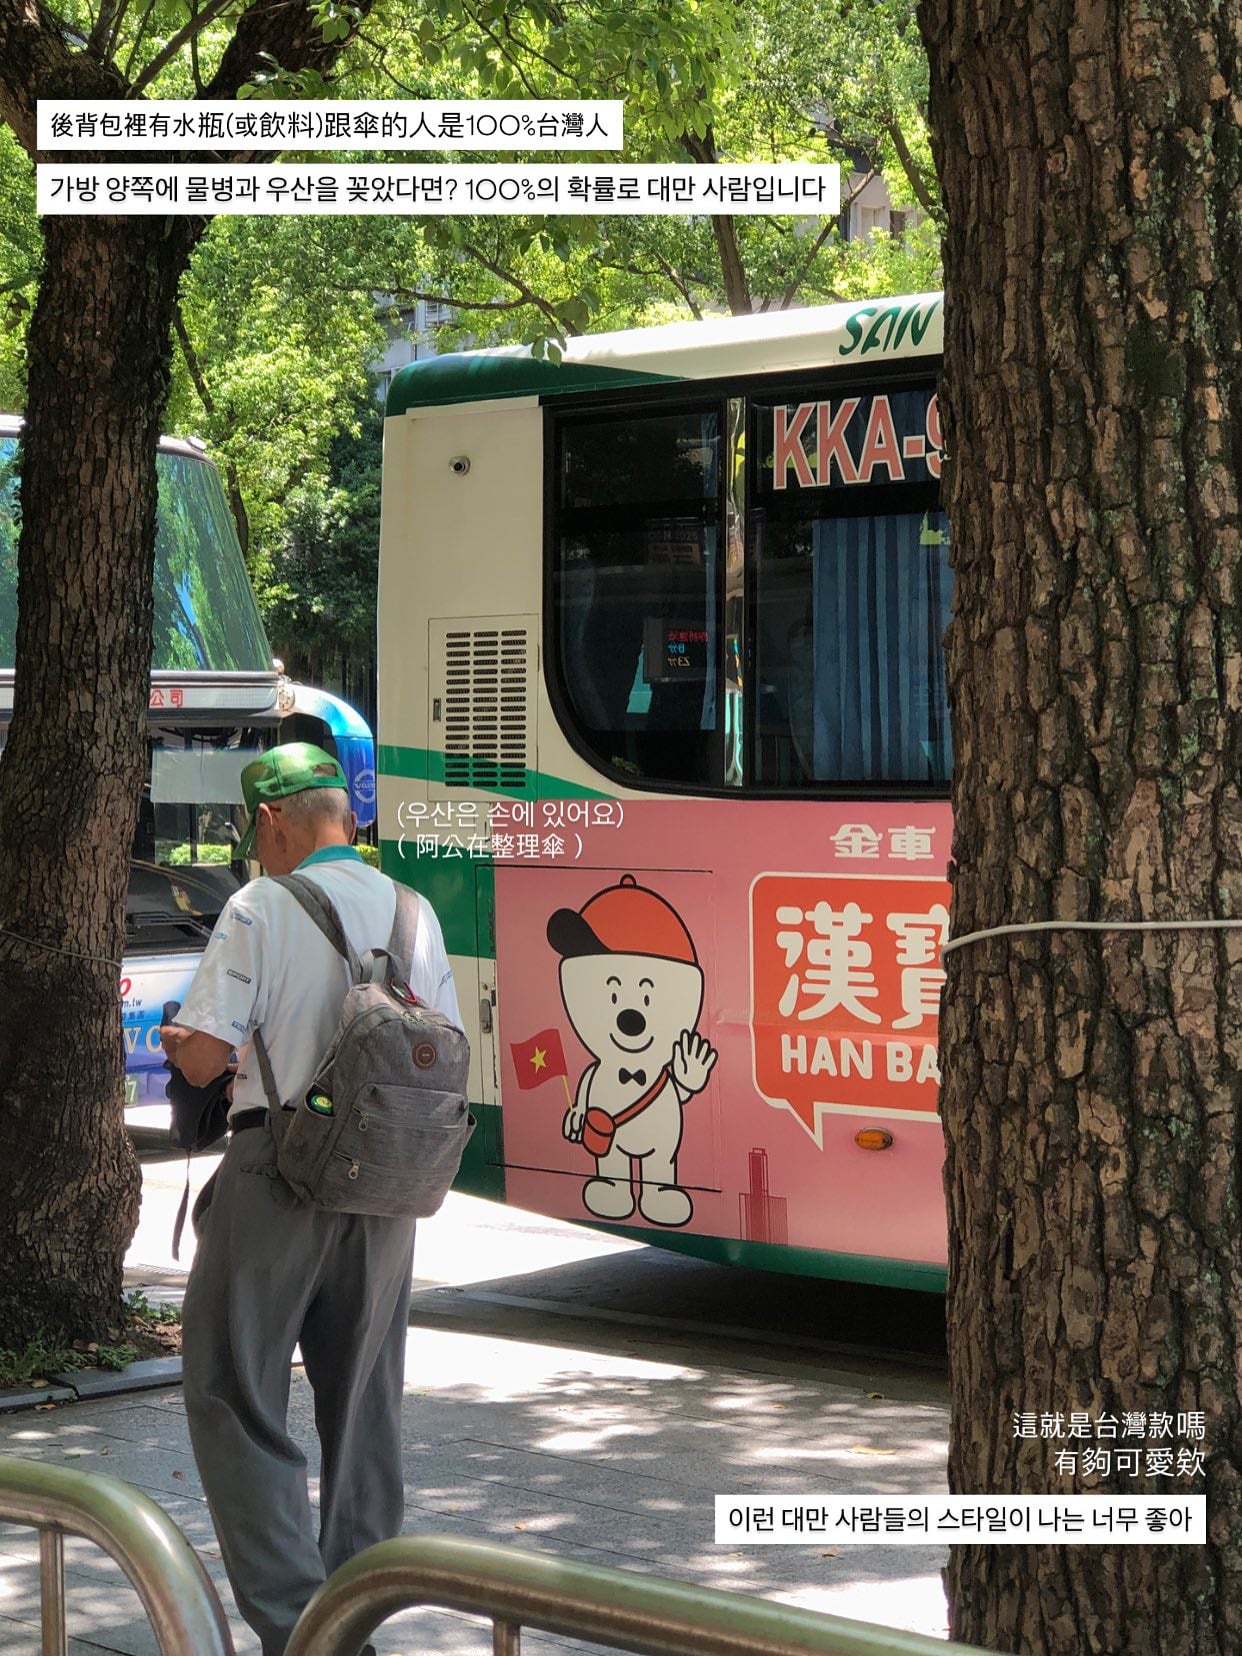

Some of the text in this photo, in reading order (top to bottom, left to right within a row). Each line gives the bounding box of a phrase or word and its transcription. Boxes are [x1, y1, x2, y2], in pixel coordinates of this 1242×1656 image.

[149, 688, 183, 708] 公司
[829, 824, 936, 860] 金車
[781, 1034, 873, 1079] HAN
